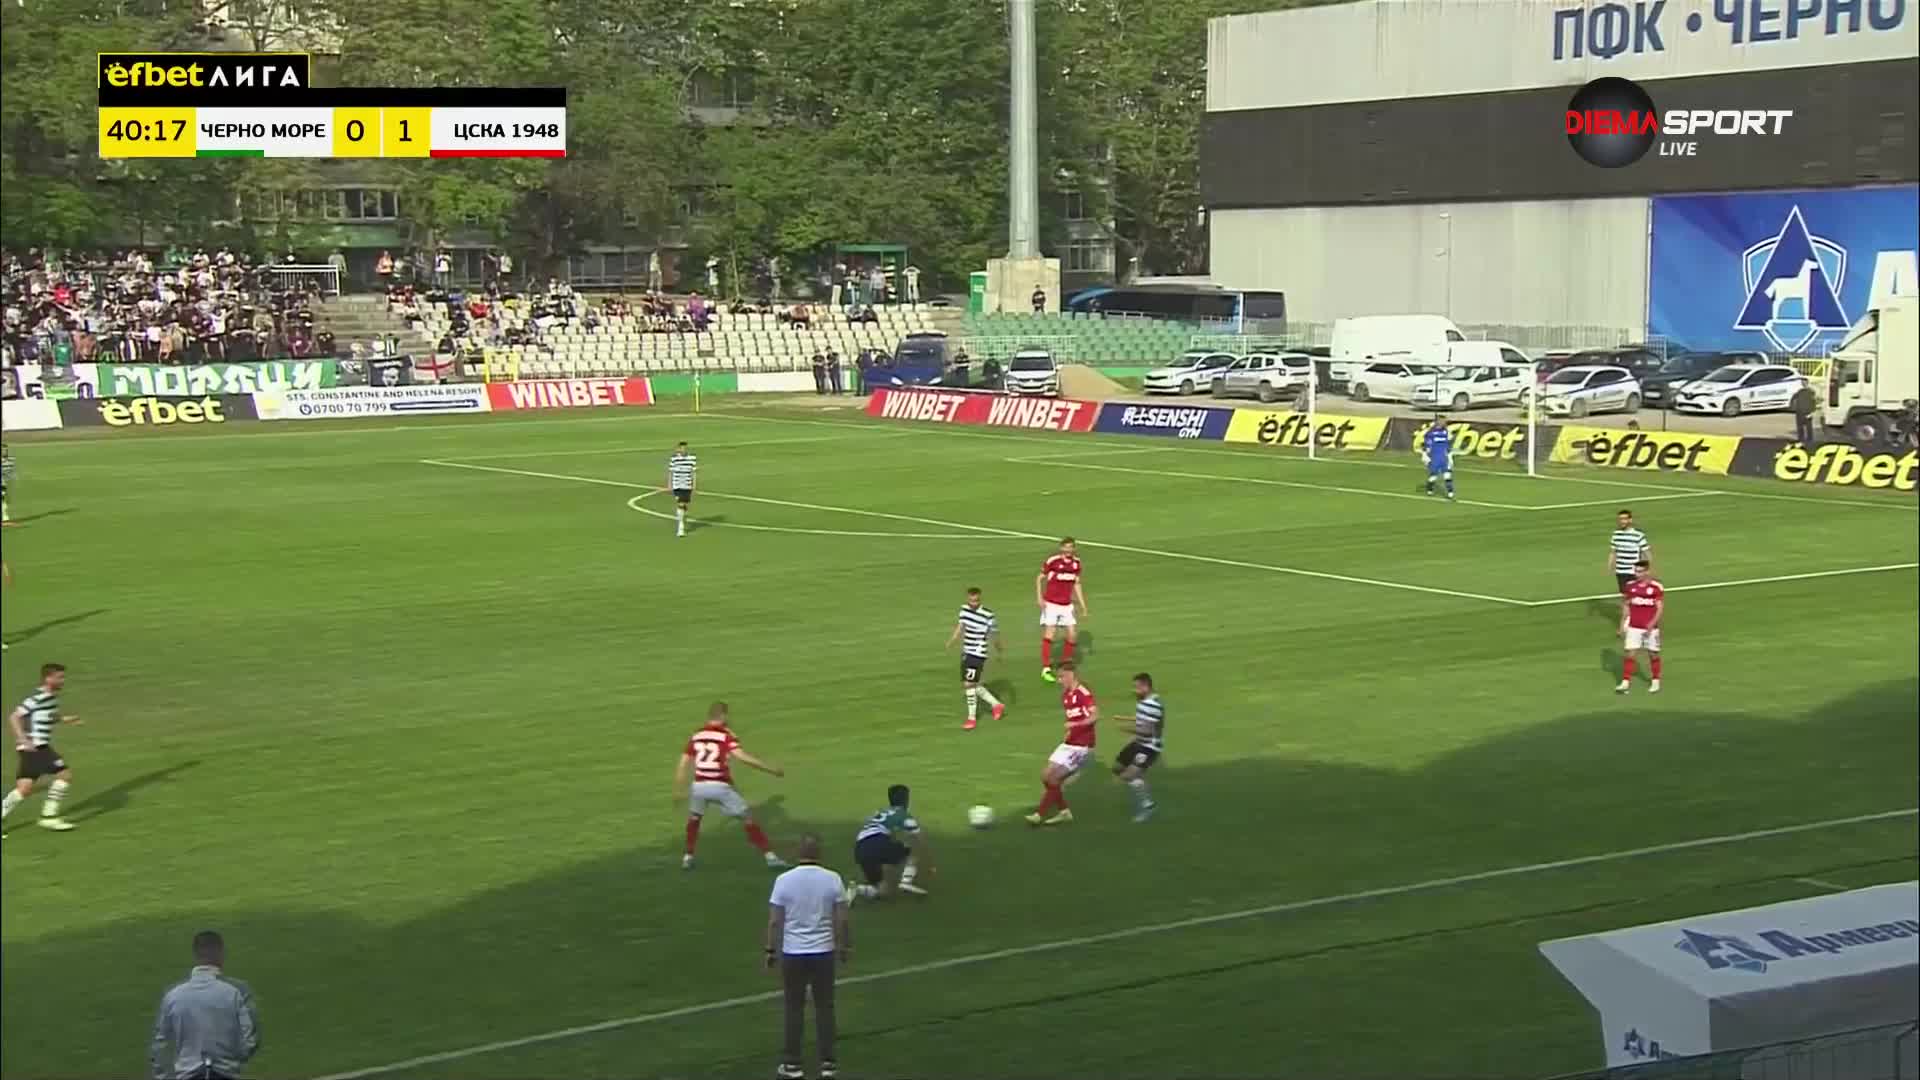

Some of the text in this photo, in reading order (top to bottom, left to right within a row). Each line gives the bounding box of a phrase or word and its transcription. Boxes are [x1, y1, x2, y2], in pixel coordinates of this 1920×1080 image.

[1553, 0, 1905, 61] ПФК ЧЕРНО
[311, 389, 380, 400] CONSTANTINE
[383, 389, 404, 399] AND
[313, 402, 387, 414] 0700 70 799
[507, 380, 625, 409] WINBET
[880, 390, 966, 422] WINBET
[987, 397, 1083, 431] WINBET
[1144, 407, 1209, 428] SENSHI
[693, 741, 720, 769] 22
